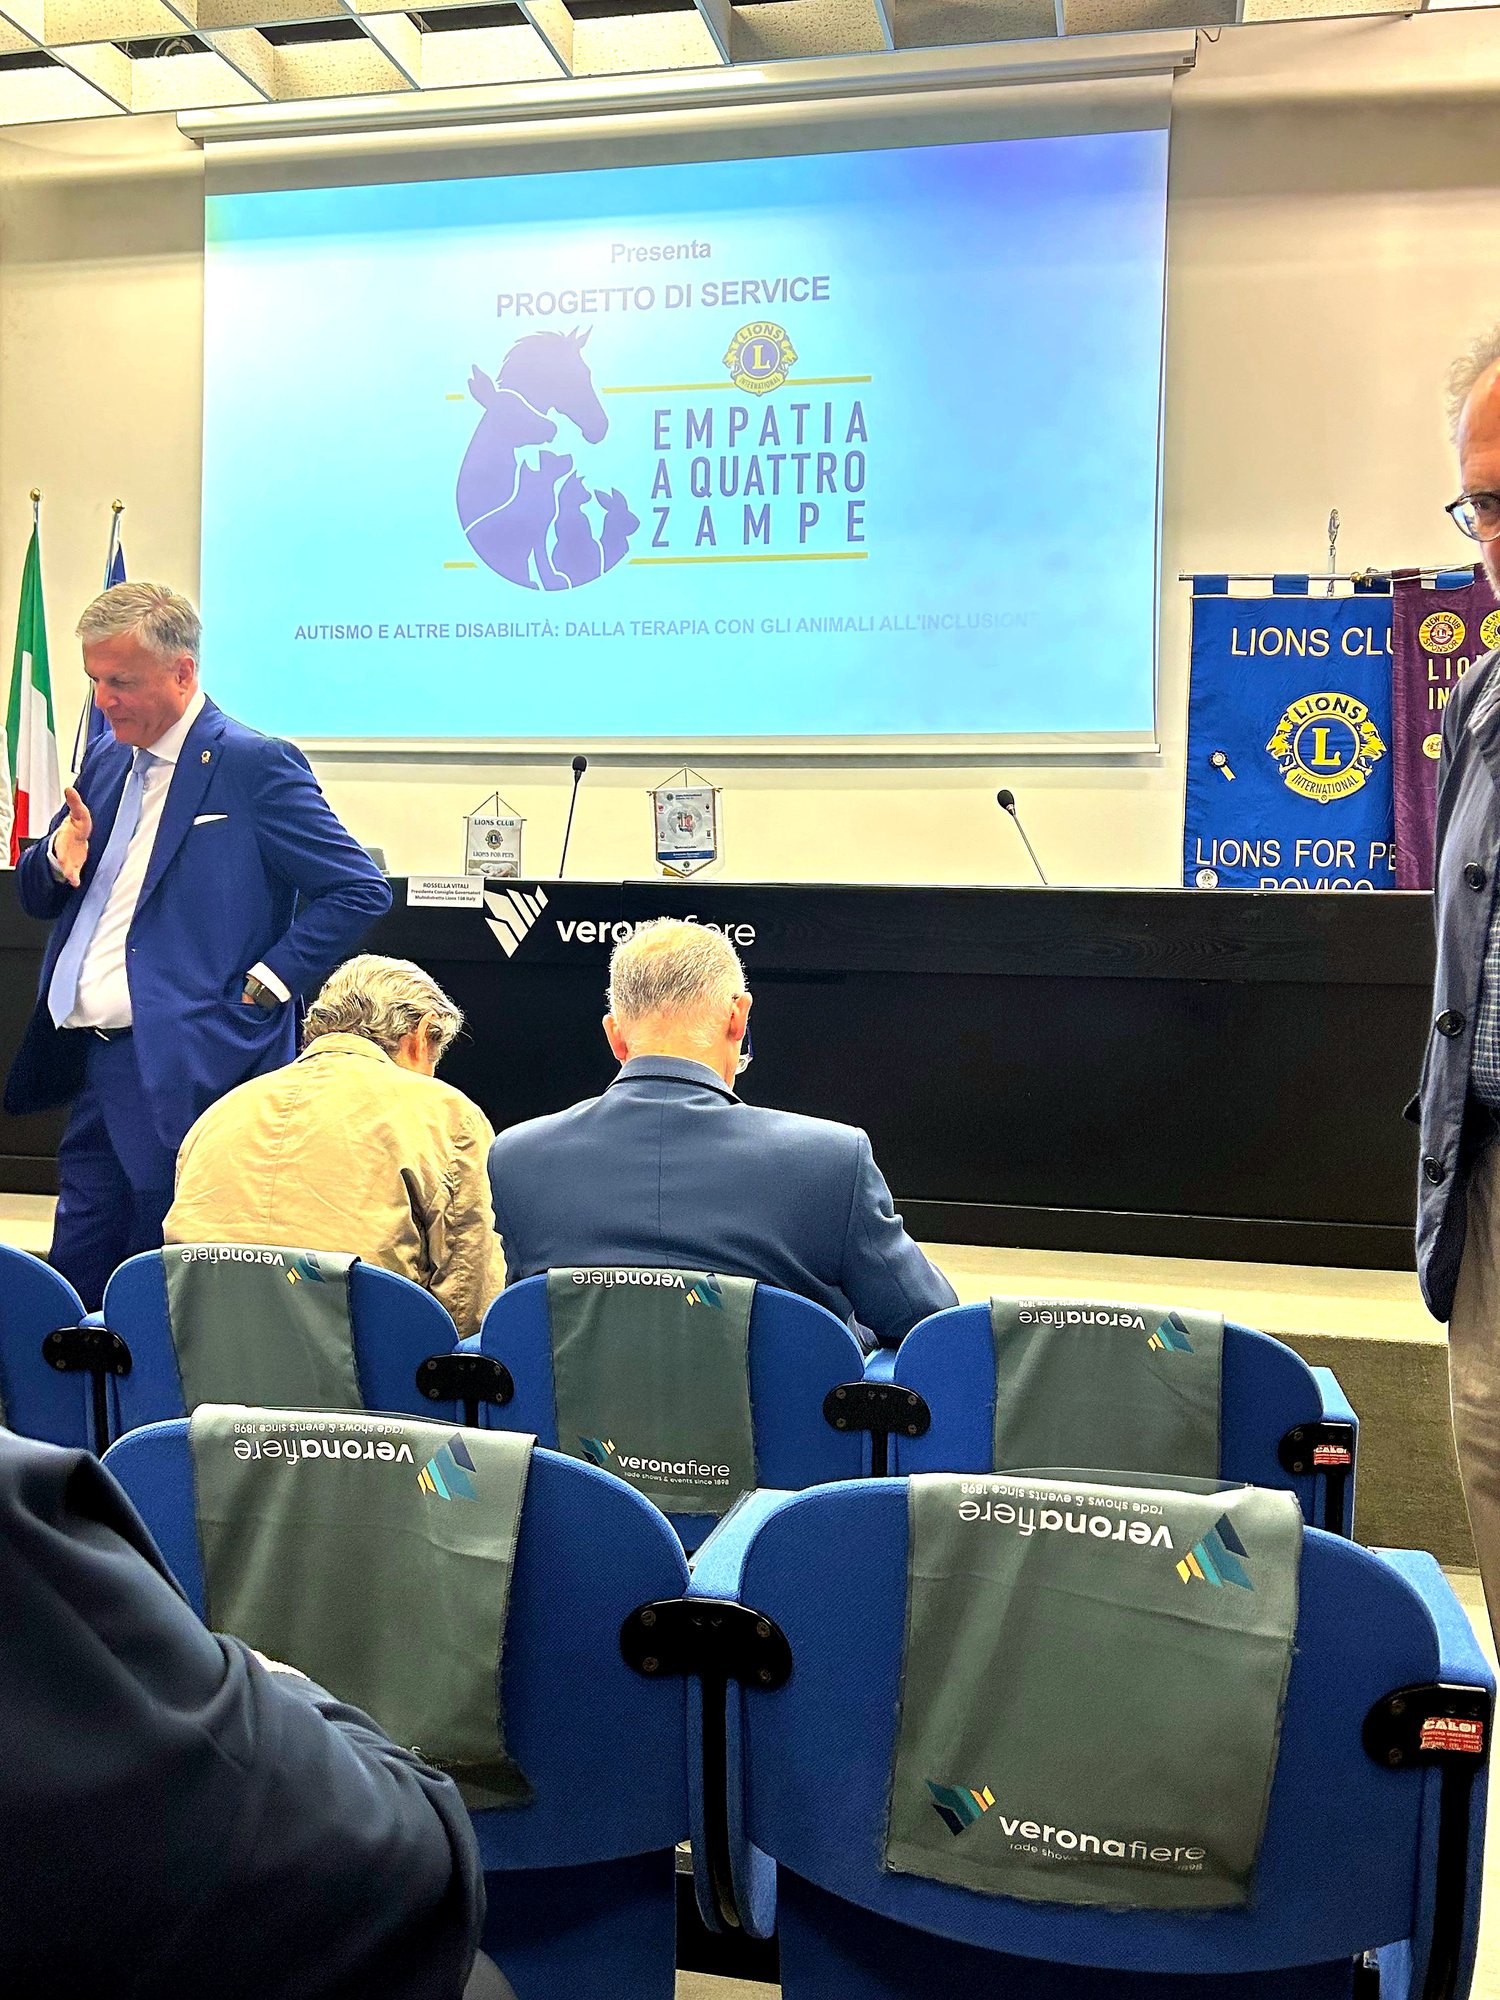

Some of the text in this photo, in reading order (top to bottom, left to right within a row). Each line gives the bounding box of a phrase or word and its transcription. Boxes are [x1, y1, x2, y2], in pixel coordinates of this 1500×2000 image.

[611, 240, 711, 264] Presenta
[497, 276, 830, 317] PROGETTO DI SERVICE
[740, 324, 782, 340] LIONS
[752, 345, 770, 369] L
[738, 376, 781, 389] INTERNATIONAL
[654, 401, 869, 450] EMPATIA
[651, 451, 866, 499] A QUATTRO
[651, 501, 866, 547] ZAMPE
[294, 624, 373, 640] AUTISMO
[378, 624, 389, 640] E
[393, 623, 450, 639] ALTRE
[455, 619, 558, 638] DISABILITÀ:
[565, 621, 625, 637] DALLA
[630, 620, 709, 636] TERAPIA
[714, 618, 755, 634] CON
[760, 617, 791, 634] GLI
[795, 616, 874, 633] ANIMALI
[1425, 615, 1461, 629] NEW CLUB
[1231, 627, 1330, 657] LIONS
[1423, 638, 1459, 652] SPONSOR
[1428, 655, 1483, 681] LIO
[1293, 697, 1362, 720] LIONS
[1311, 728, 1341, 765] L
[1292, 774, 1360, 794] INTERNATIONAL
[1196, 838, 1397, 871] LIONS FOR PE
[181, 1247, 284, 1267] veronafiere
[572, 1270, 685, 1289] veronafiere
[1019, 1310, 1145, 1330] veronafiere
[234, 1423, 256, 1434] 1898
[259, 1424, 286, 1433] since
[290, 1423, 325, 1433] events
[339, 1424, 374, 1435] shows
[377, 1425, 404, 1435] rade
[233, 1439, 414, 1465] veronafiere
[617, 1455, 730, 1477] veronafiere
[642, 1473, 662, 1482] shows
[961, 1482, 1165, 1515] rade shows & events since 1898
[958, 1500, 1174, 1549] veronafiere
[1423, 1720, 1477, 1733] CALOI
[999, 1815, 1206, 1861] veronafiere
